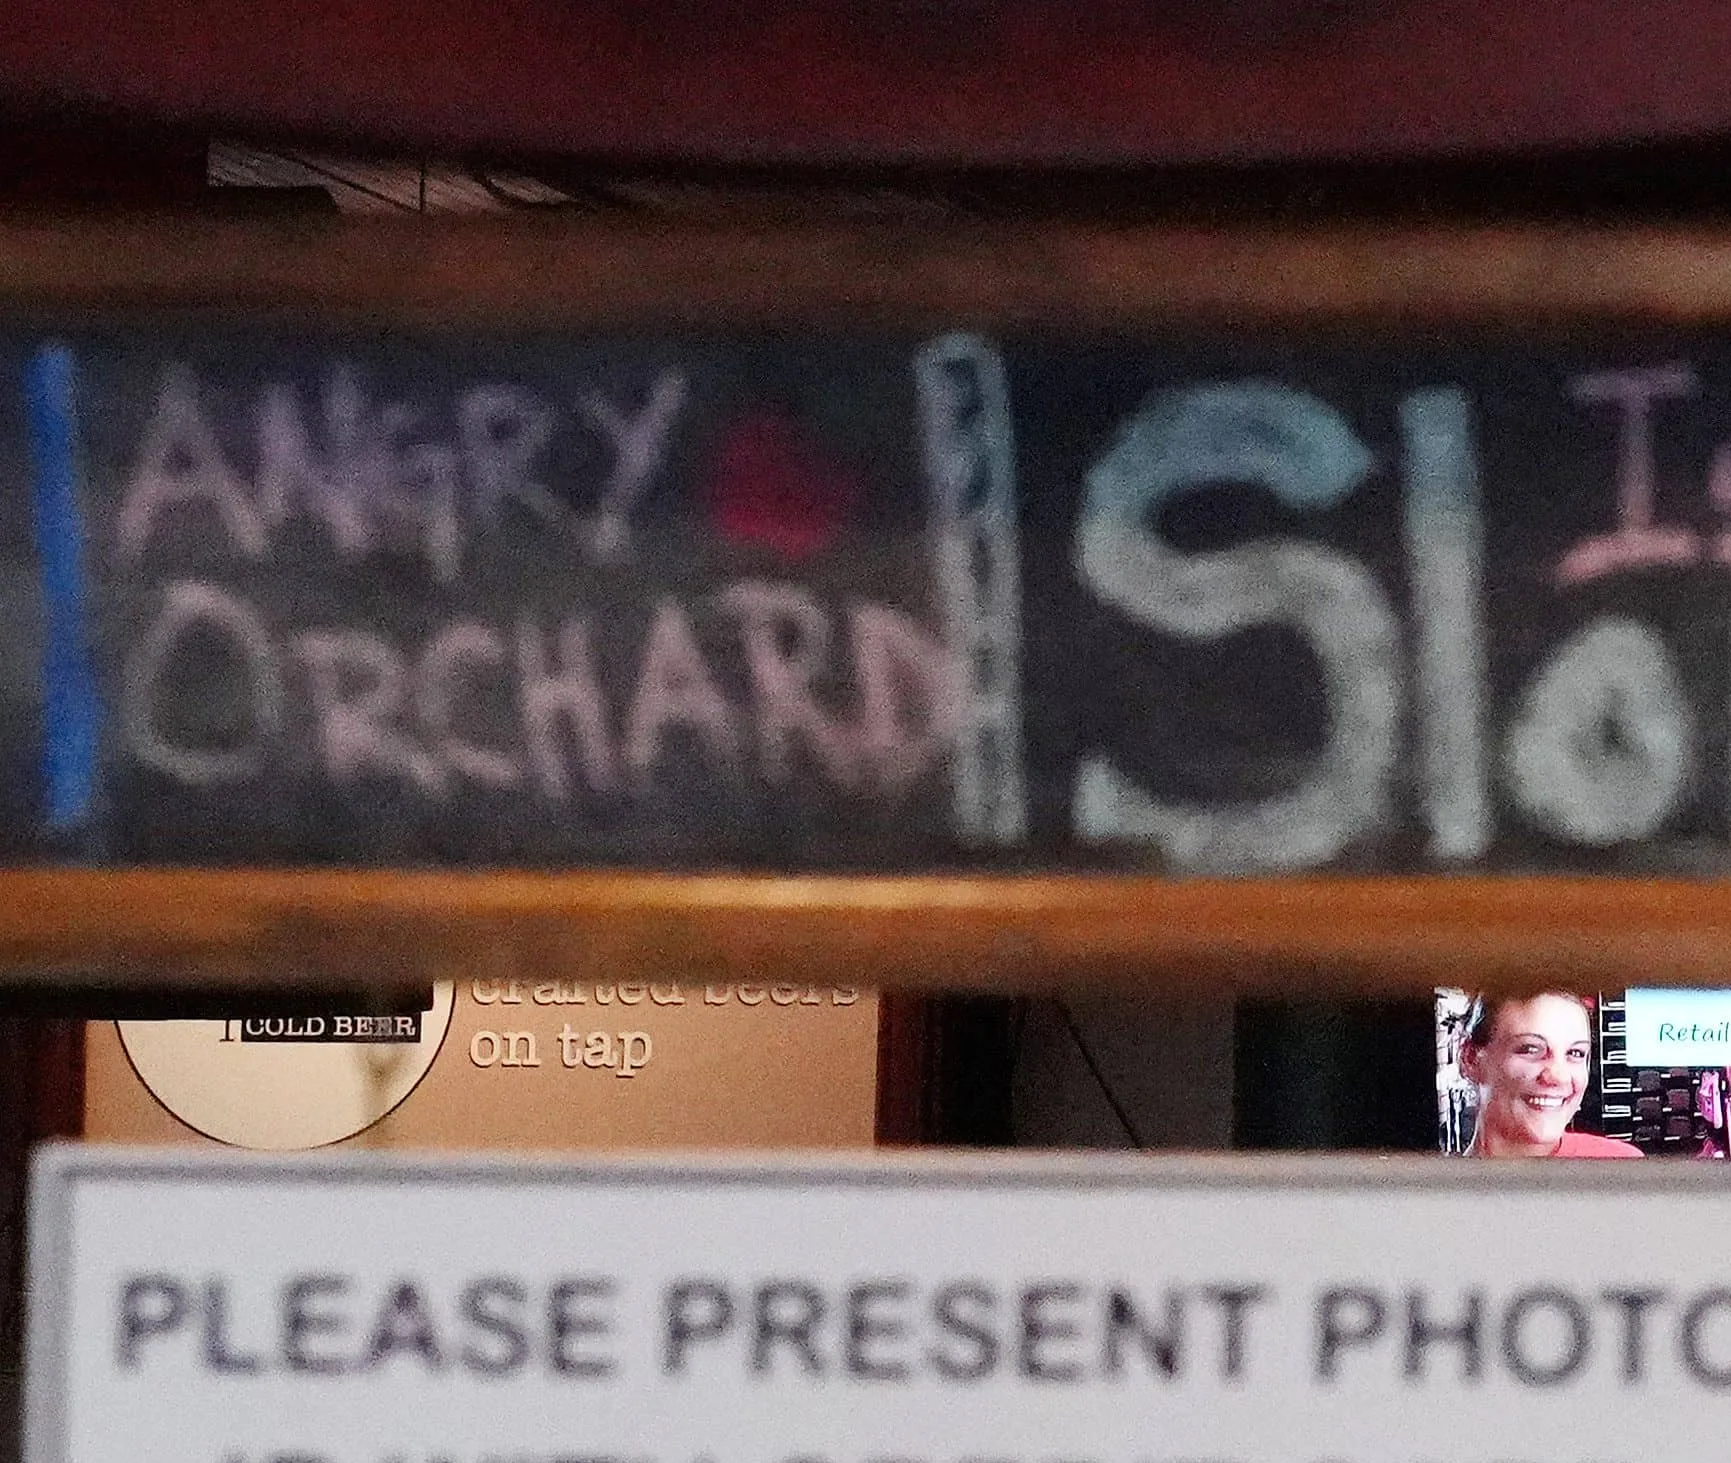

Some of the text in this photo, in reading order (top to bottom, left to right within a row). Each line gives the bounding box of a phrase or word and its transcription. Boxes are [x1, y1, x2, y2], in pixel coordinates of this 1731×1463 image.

[115, 362, 690, 585] ANGRY
[118, 578, 955, 800] ORCHARD
[245, 1016, 326, 1037] COLD
[333, 1016, 417, 1037] BEER
[469, 1022, 653, 1078] on tap
[1658, 1021, 1730, 1043] Retail
[115, 1272, 618, 1378] PLEASE
[661, 1275, 1270, 1386] PRESENT
